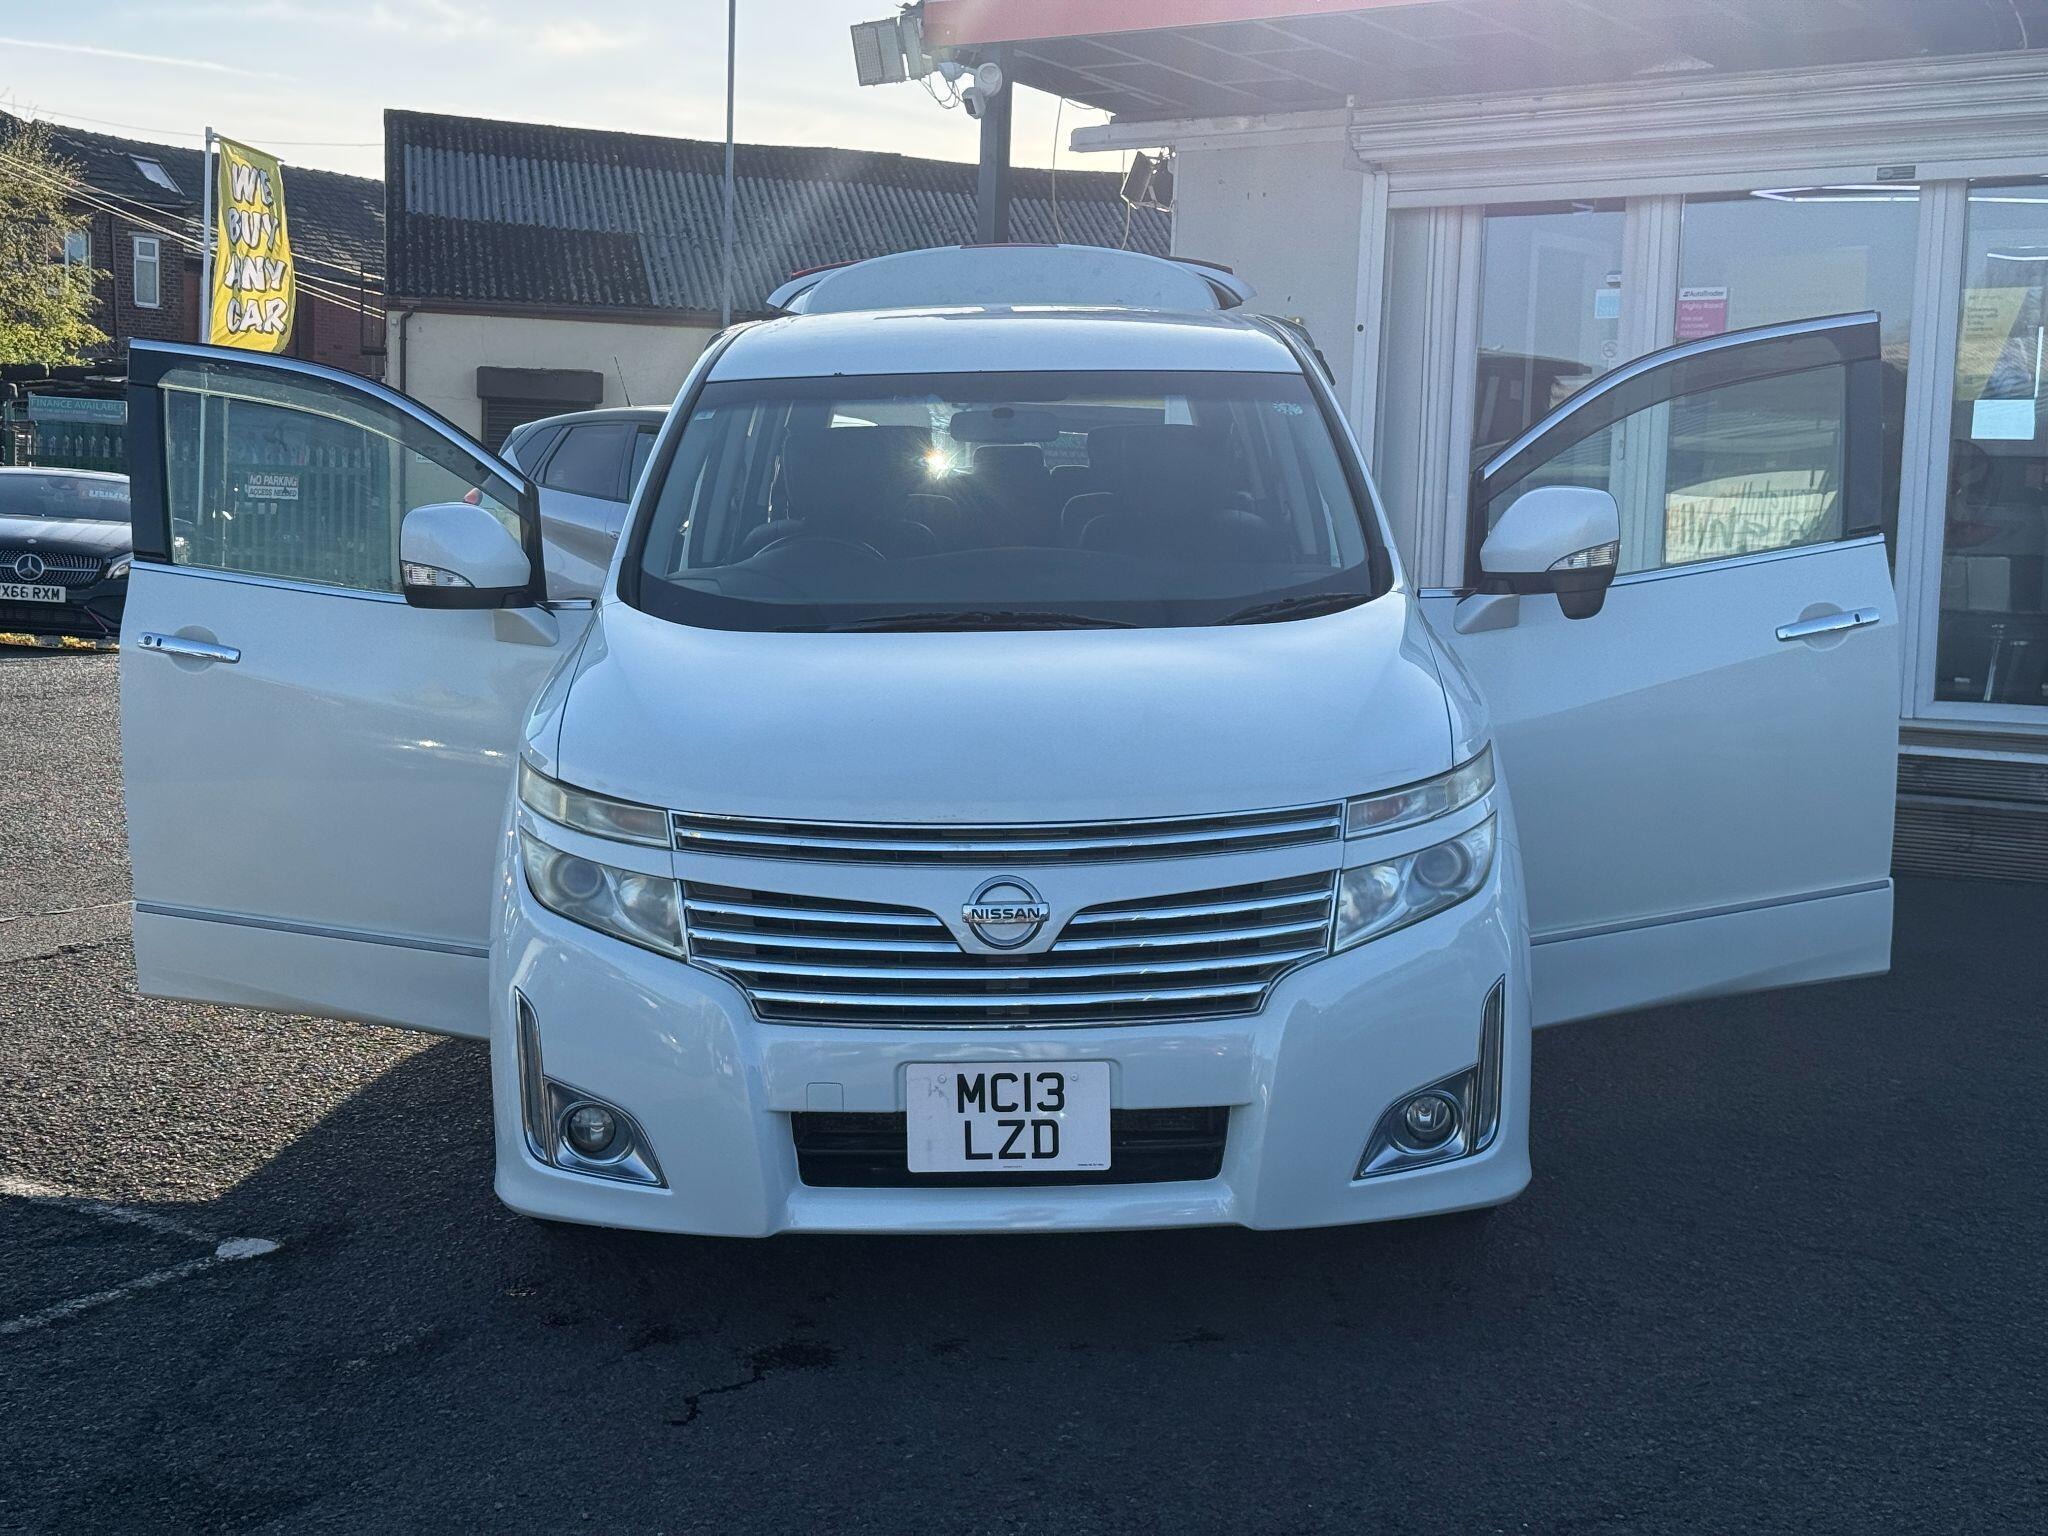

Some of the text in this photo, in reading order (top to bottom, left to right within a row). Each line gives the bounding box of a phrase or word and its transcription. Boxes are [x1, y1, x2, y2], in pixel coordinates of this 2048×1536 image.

[231, 161, 273, 207] WE
[228, 207, 279, 253] BUY
[224, 252, 287, 293] ANY
[226, 297, 287, 335] CAR
[30, 399, 72, 409] FINANCE
[74, 401, 125, 411] AVAILABLE
[249, 474, 298, 487] NO PARKING
[249, 488, 273, 496] ACCESS
[0, 584, 60, 600] X66 RXM
[971, 907, 1040, 920] NISSAN
[956, 1072, 1065, 1113] MC13
[964, 1119, 1060, 1160] LZD
